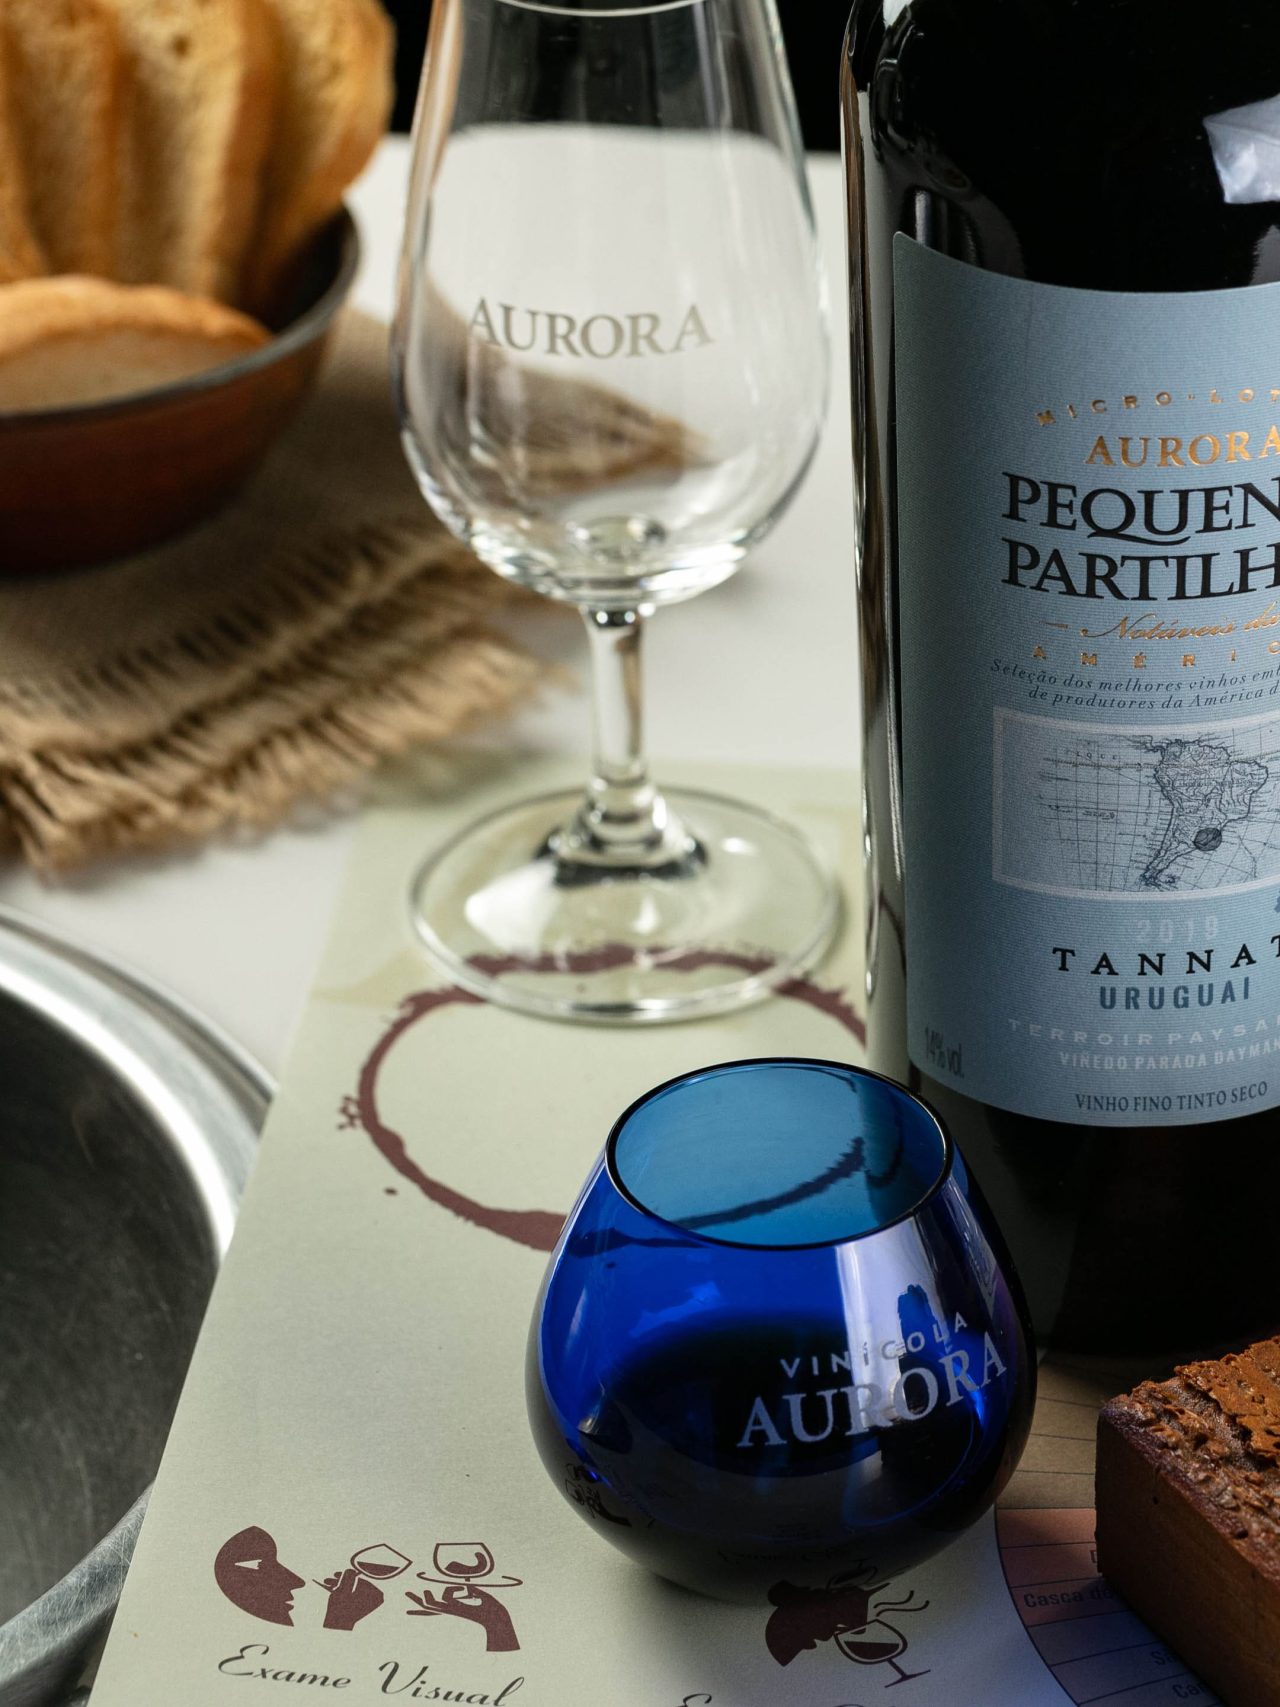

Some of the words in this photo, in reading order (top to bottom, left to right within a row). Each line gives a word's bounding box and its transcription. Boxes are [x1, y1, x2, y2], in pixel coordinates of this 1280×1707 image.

[469, 297, 715, 360] AURORA
[989, 658, 1058, 685] Seleção
[1063, 673, 1093, 690] dos
[1099, 677, 1183, 694] melhores
[1189, 672, 1247, 692] vinhos
[1028, 686, 1048, 700] de
[1052, 693, 1155, 709] produtores
[1161, 696, 1183, 709] da
[1189, 685, 1264, 708] América
[1136, 914, 1219, 944] 2019
[1100, 976, 1250, 1010] URUGUAI
[1008, 1018, 1153, 1046] TERROIR
[1135, 1053, 1207, 1071] PARADA
[1075, 1093, 1130, 1112] VINHO
[1134, 1094, 1173, 1112] FINO
[1177, 1089, 1227, 1111] TINTO
[1231, 1080, 1268, 1108] SECO
[736, 1330, 1008, 1448] AURORA
[1023, 1589, 1083, 1609] Casca
[217, 1643, 352, 1689] Exame
[378, 1660, 526, 1707] Visual
